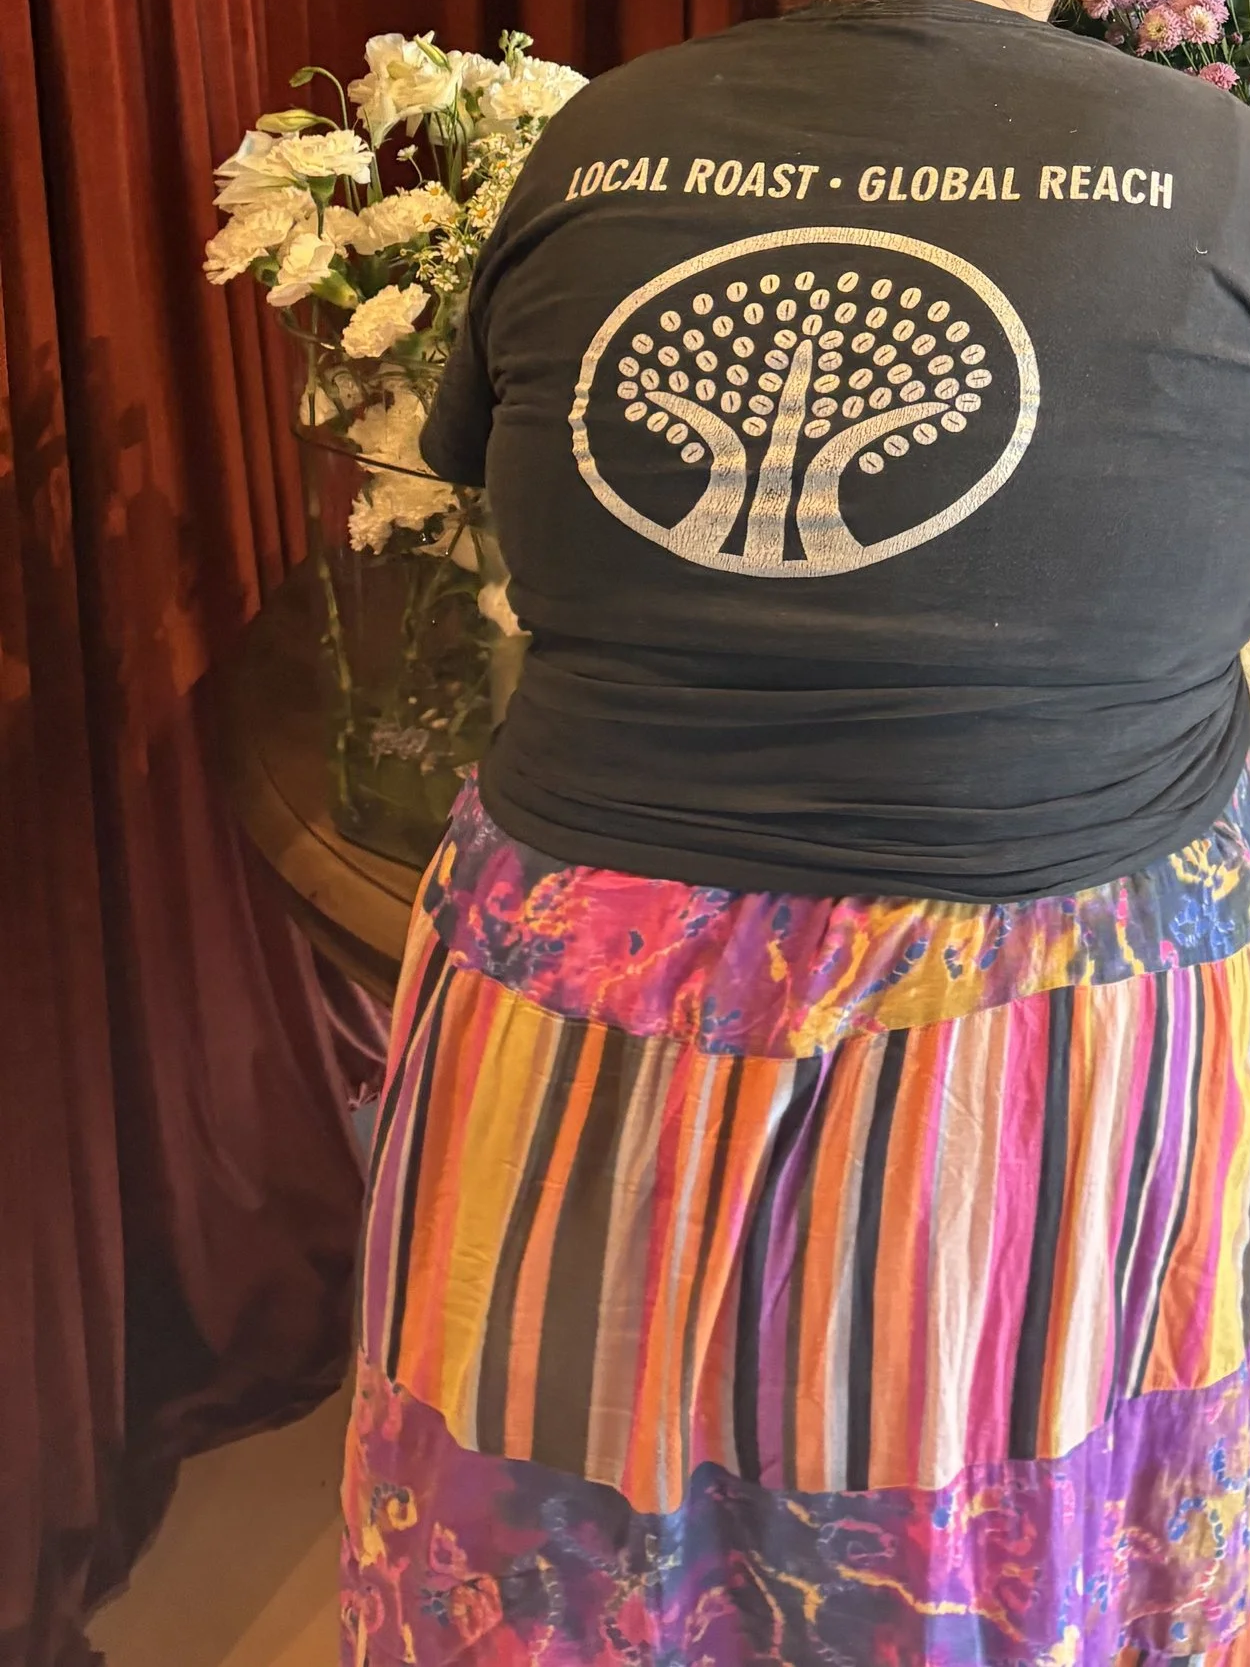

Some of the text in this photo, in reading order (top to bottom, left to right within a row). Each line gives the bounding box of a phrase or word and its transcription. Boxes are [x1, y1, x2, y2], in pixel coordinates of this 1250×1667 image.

[564, 156, 1174, 210] LOCAL ROAST GLOBAL REACH
